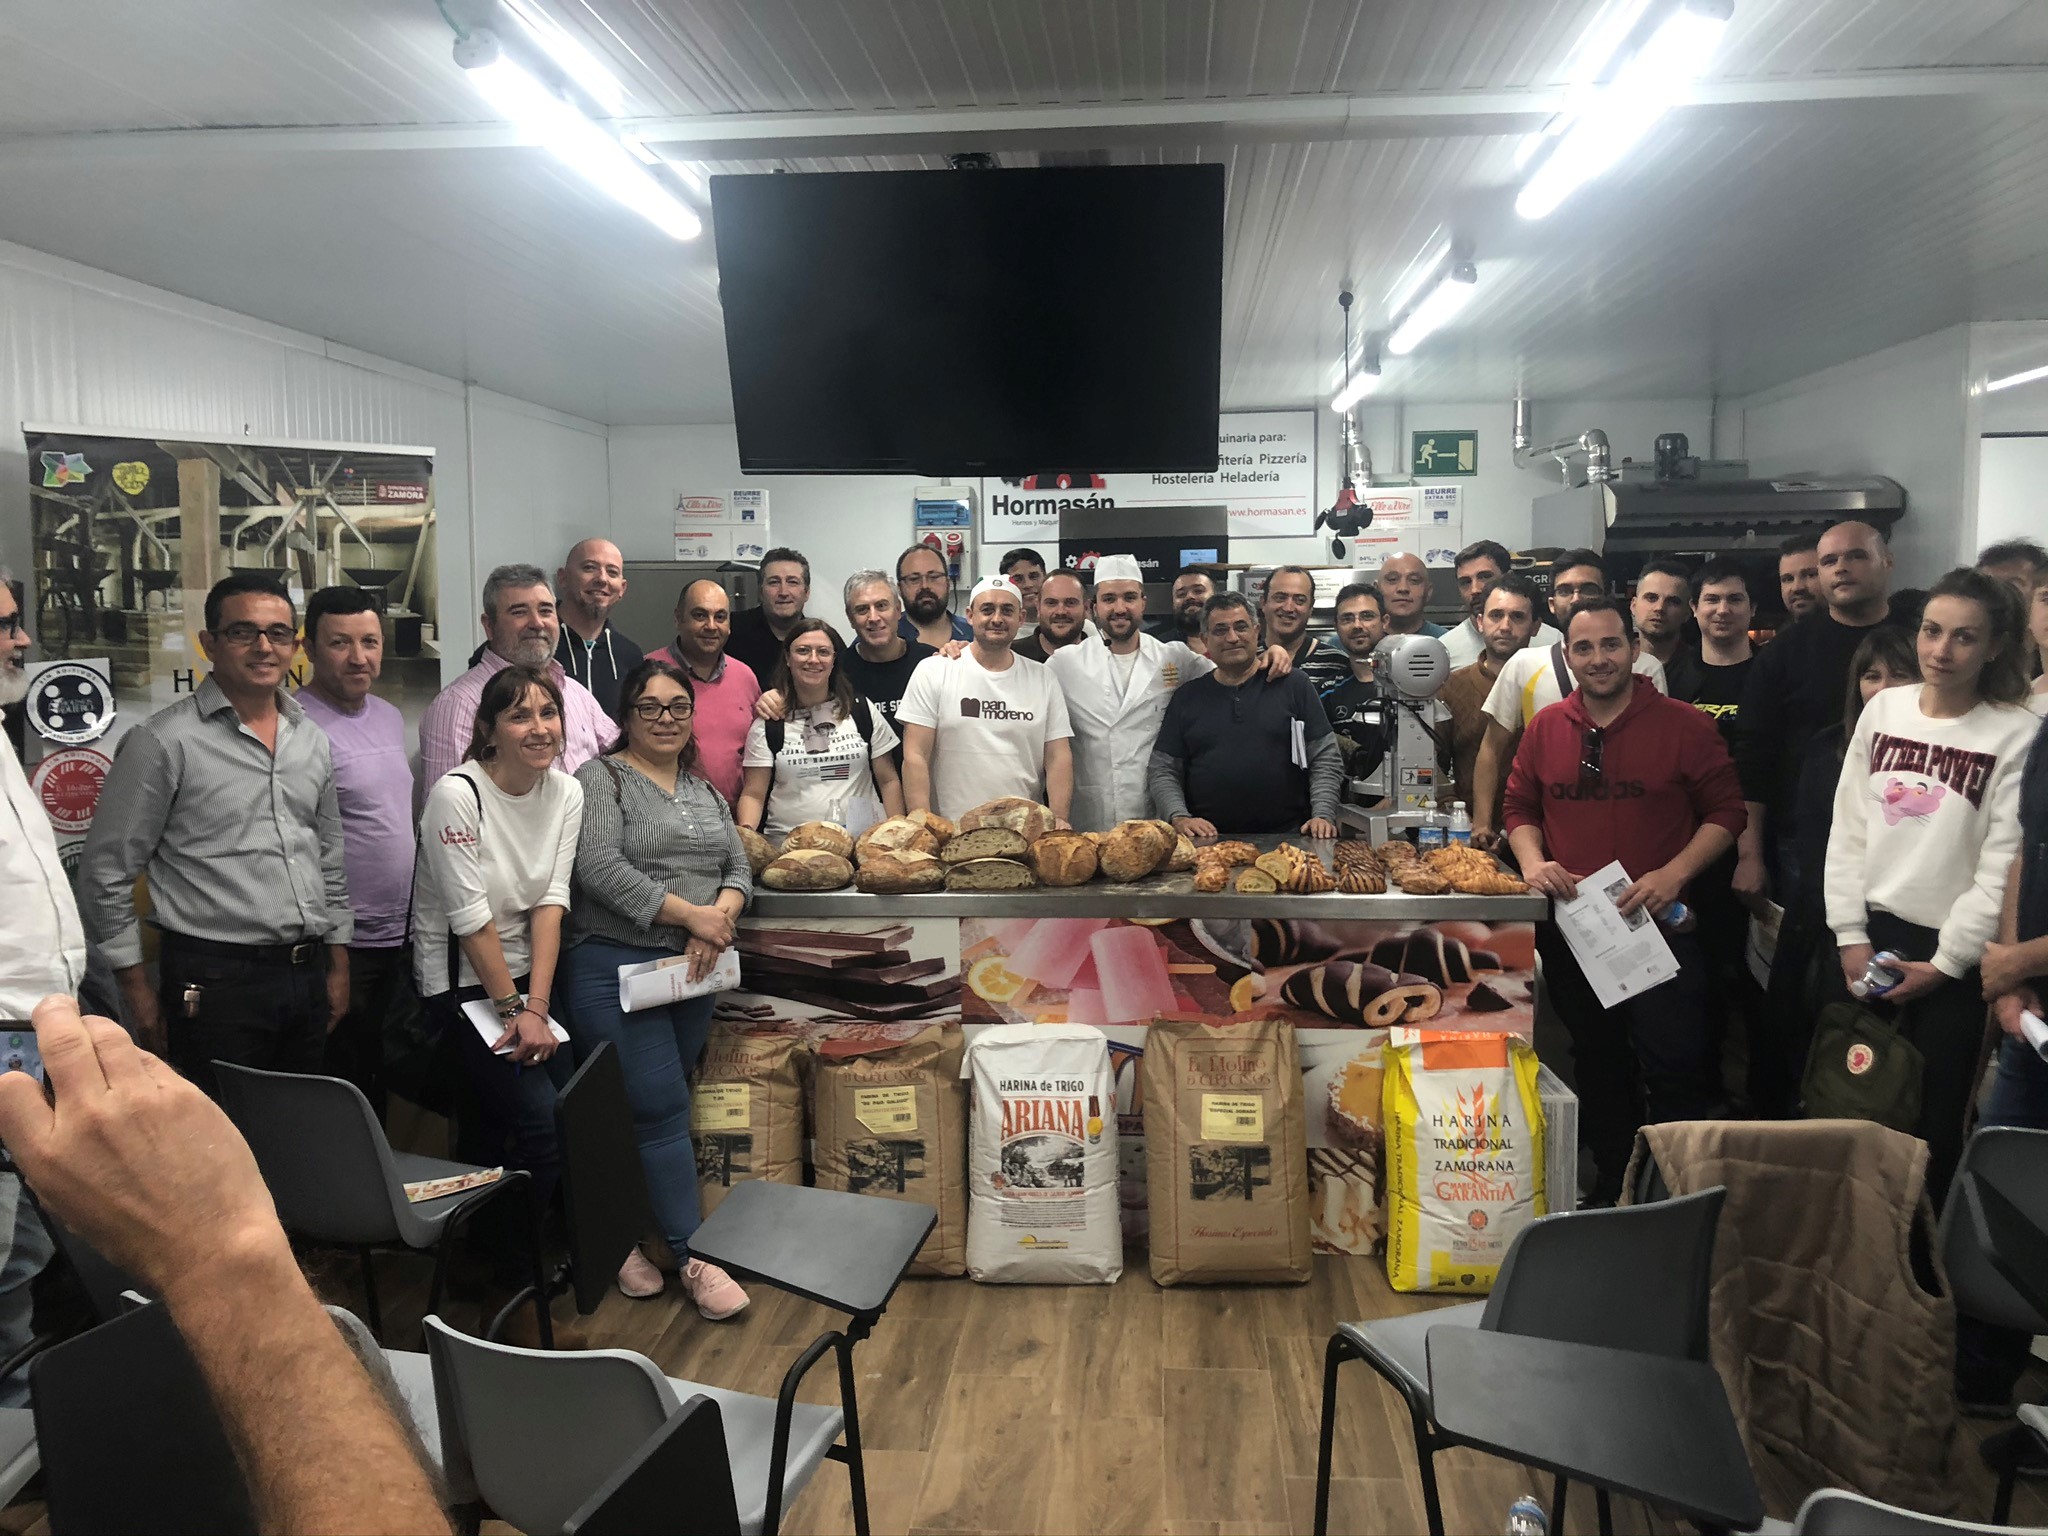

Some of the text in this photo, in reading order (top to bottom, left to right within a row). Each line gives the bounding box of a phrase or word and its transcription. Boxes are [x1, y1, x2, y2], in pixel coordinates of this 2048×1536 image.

[1219, 433, 1286, 445] uinaria para:
[1259, 453, 1307, 464] Pizzería
[1152, 471, 1280, 484] Hostelería Heladería
[387, 490, 424, 499] ZAMORA
[1228, 507, 1307, 516] ww.hormasan.es
[982, 700, 1006, 712] pan
[984, 710, 1033, 721] moreno
[813, 752, 860, 763] HAPPINESS
[999, 1080, 1084, 1092] HARINA de TRIGO
[1001, 1099, 1085, 1141] ARIANA
[1433, 1114, 1512, 1127] HARINA
[1433, 1138, 1513, 1149] TRADICIONAL
[1435, 1160, 1514, 1171] ZAMORANA
